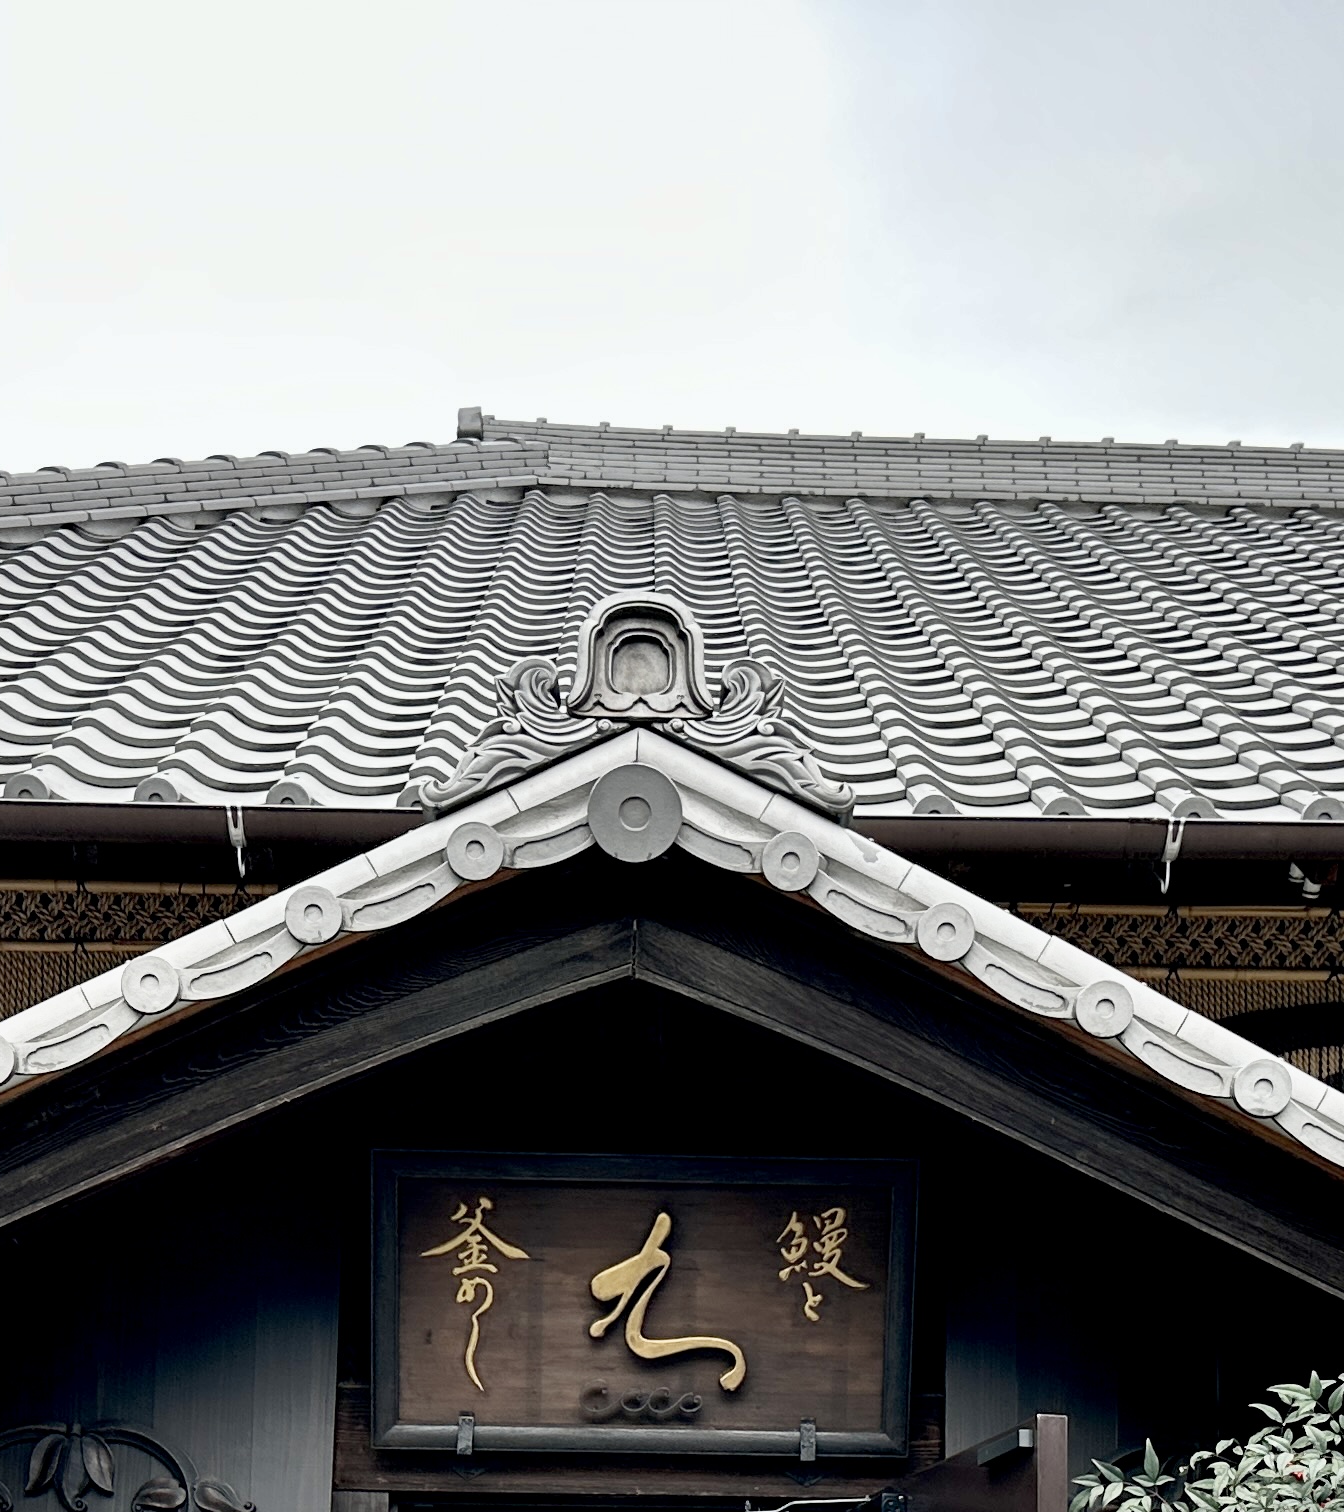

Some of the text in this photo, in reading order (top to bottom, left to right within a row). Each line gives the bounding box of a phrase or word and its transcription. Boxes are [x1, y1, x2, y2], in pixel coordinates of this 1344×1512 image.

[421, 1196, 531, 1392] 釜めし
[588, 1211, 747, 1391] 九
[774, 1207, 870, 1322] 鰻と
